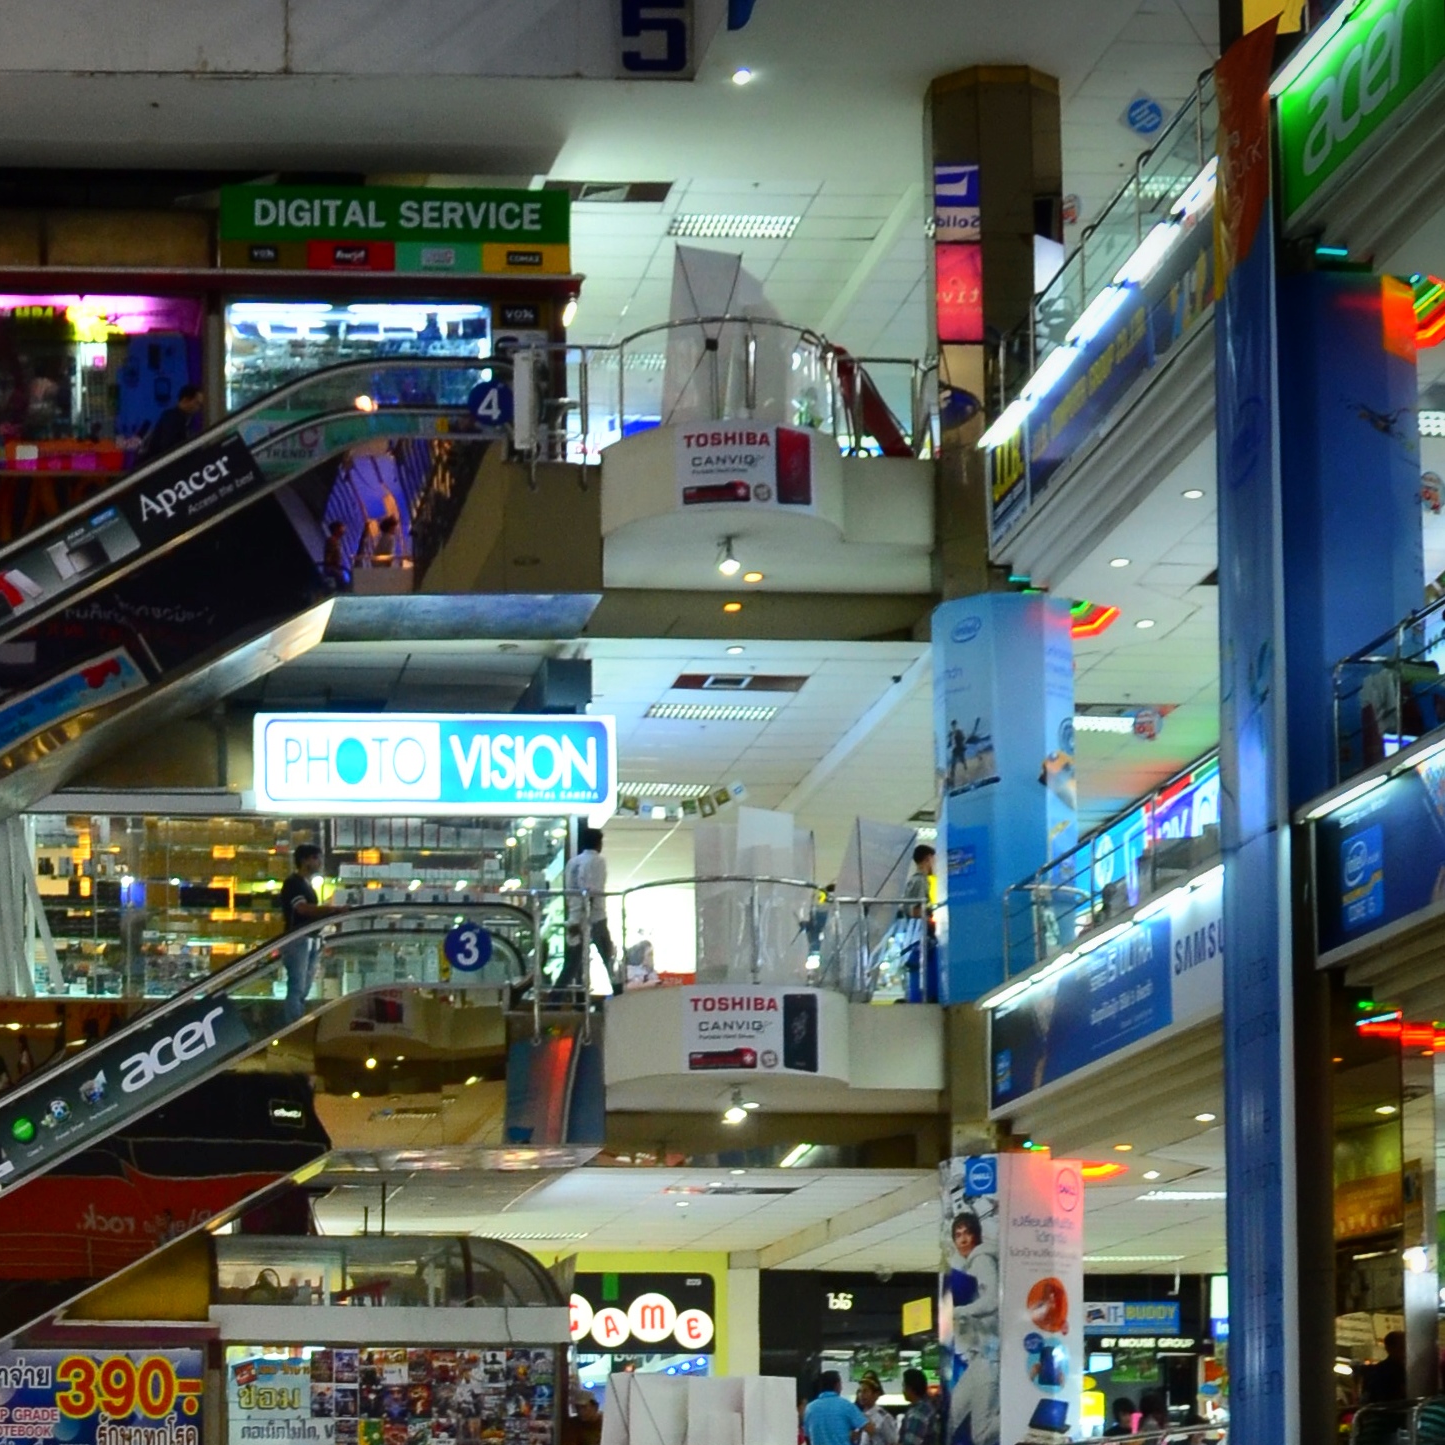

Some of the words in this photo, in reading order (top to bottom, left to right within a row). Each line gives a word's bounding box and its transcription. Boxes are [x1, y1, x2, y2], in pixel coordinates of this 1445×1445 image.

[622, 0, 687, 72] 5
[1303, 2, 1407, 177] acer
[254, 198, 387, 229] DIGITAL
[399, 201, 543, 231] SERVICE
[477, 387, 503, 421] 4
[684, 432, 771, 449] TOSHIBA
[137, 452, 231, 523] Apacer
[283, 736, 426, 788] PHOTO
[448, 734, 598, 793] VISION
[456, 931, 480, 965] 3
[689, 997, 779, 1013] TOSHIBA
[120, 1005, 224, 1093] acer
[1101, 1337, 1119, 1350] BY
[1120, 1337, 1157, 1350] MOUSE
[1158, 1337, 1196, 1350] GROUP
[12, 1407, 61, 1424] GRADE
